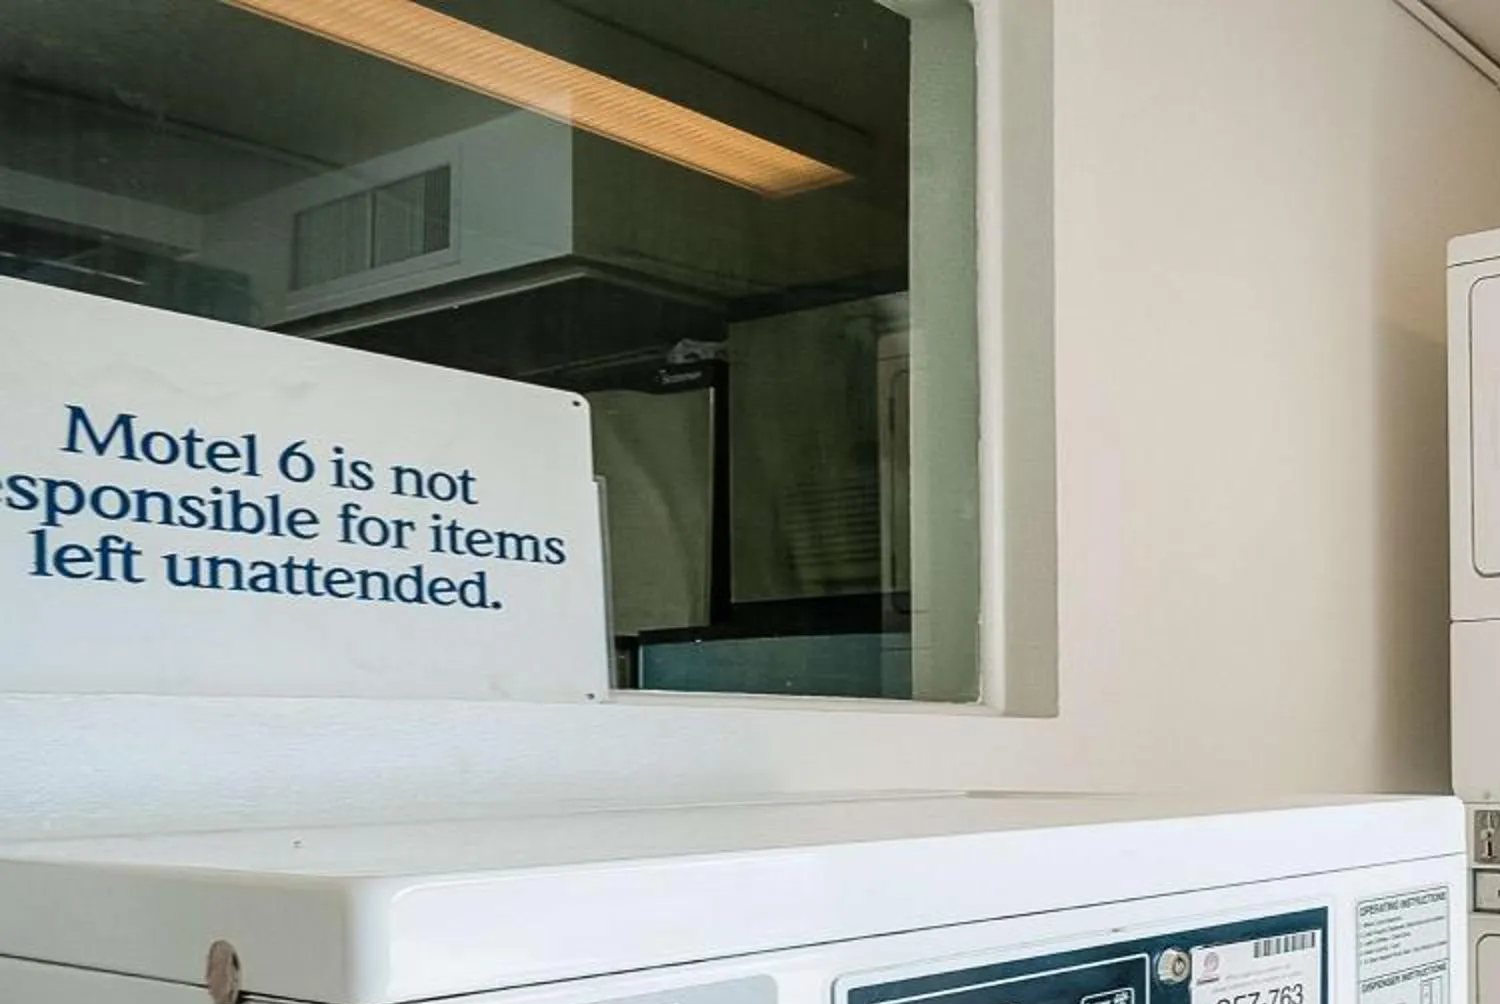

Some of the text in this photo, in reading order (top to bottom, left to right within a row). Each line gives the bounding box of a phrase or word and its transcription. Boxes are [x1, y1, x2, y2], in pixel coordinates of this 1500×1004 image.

[61, 403, 479, 506] Motel 6 is not
[0, 472, 567, 565] sponsible for items
[29, 528, 504, 611] left unattended.
